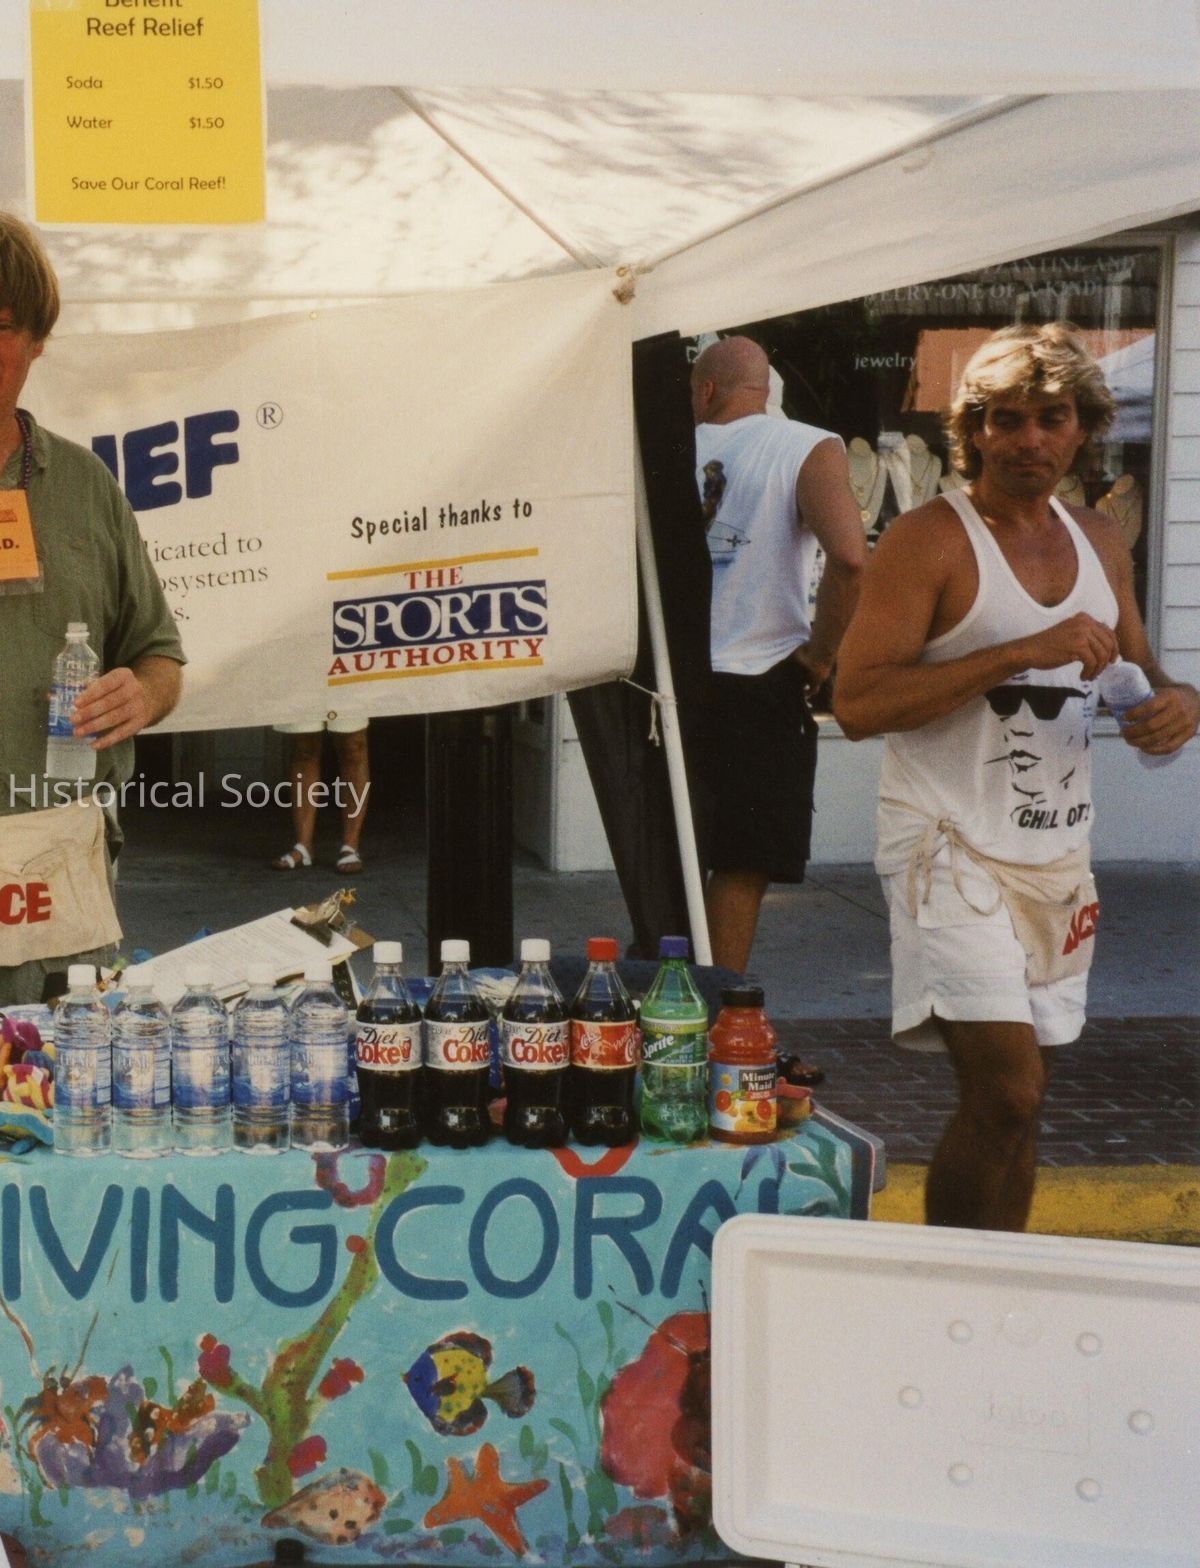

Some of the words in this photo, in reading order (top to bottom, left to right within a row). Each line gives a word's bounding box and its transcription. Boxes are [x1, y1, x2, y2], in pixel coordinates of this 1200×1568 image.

[86, 17, 136, 37] Reef
[143, 17, 204, 37] Relief
[66, 76, 103, 89] Soda
[188, 76, 224, 90] $1.50
[67, 115, 113, 129] Water
[189, 116, 225, 130] $1.50
[71, 177, 107, 191] Save
[111, 177, 139, 191] Our
[145, 177, 184, 191] Coral
[189, 177, 226, 190] Reef!
[854, 352, 917, 370] jewelry
[351, 507, 428, 544] Special
[438, 499, 502, 529] thanks
[512, 498, 532, 519] to
[237, 536, 263, 553] to
[402, 565, 464, 591] THE
[333, 584, 548, 650] SPORTS
[328, 638, 544, 677] AUTHORITY
[363, 1027, 397, 1044] Diet
[459, 1027, 488, 1043] Diet
[525, 1027, 560, 1043] Diet
[356, 1037, 400, 1064] Coke
[443, 1039, 489, 1062] Coke
[511, 1038, 563, 1063] Coke
[643, 1035, 674, 1059] Sprite
[742, 1072, 775, 1081] Minute
[748, 1082, 772, 1091] Maid
